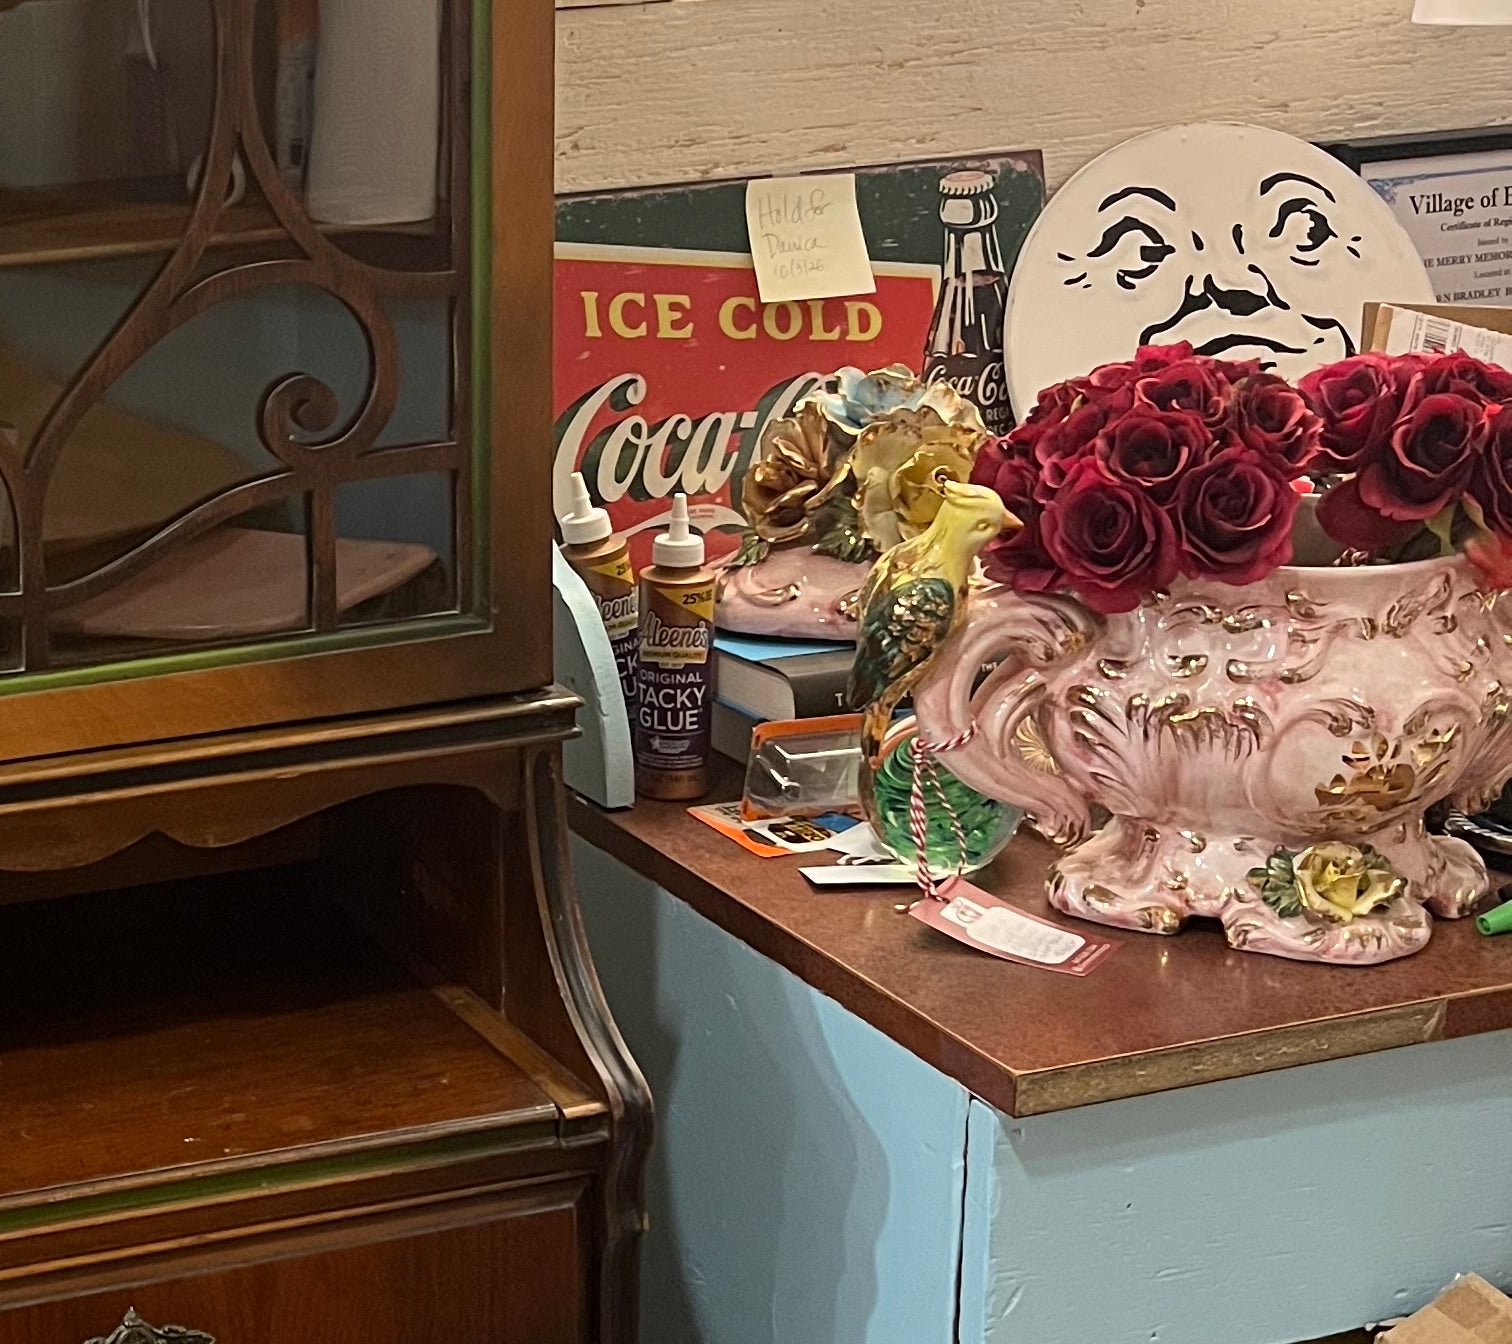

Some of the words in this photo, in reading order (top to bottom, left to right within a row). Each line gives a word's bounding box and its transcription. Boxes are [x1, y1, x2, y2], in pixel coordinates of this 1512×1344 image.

[1409, 192, 1475, 217] Village
[1480, 187, 1500, 209] of
[1436, 254, 1473, 268] MERRY
[1453, 287, 1501, 301] BRADLEY
[580, 291, 694, 339] ICE
[718, 296, 883, 342] COLD
[639, 610, 709, 648] Aleene's
[639, 668, 704, 685] ORIGINAL
[638, 684, 707, 709] TACKY
[639, 706, 700, 731] GLUE
